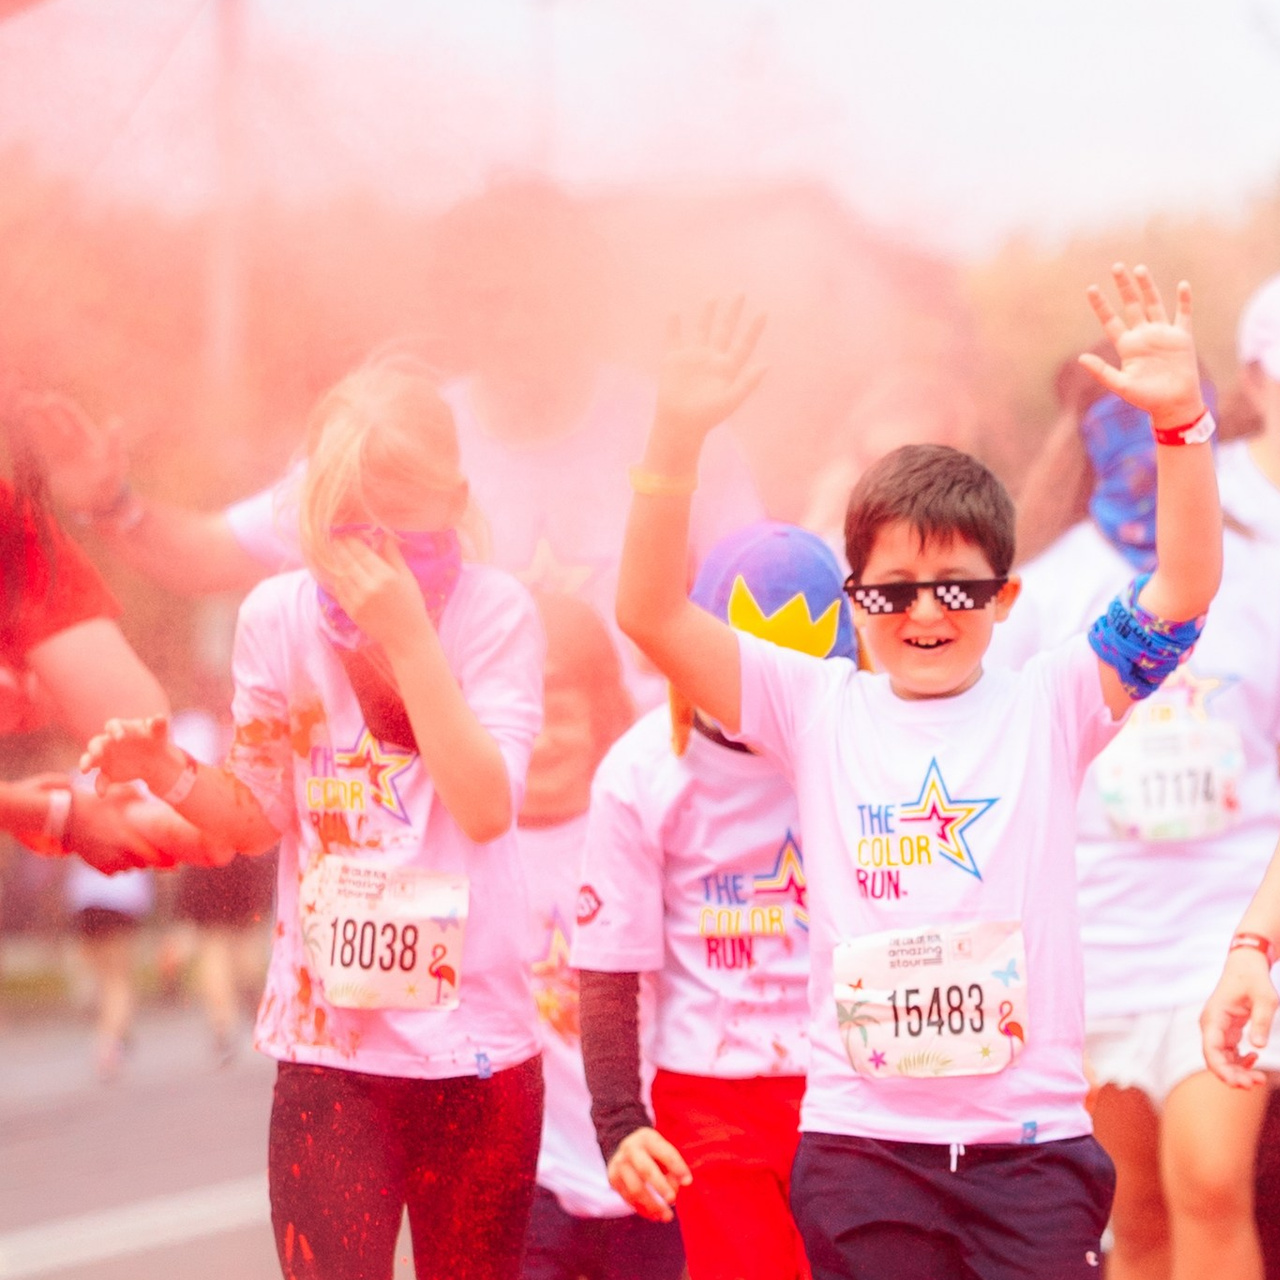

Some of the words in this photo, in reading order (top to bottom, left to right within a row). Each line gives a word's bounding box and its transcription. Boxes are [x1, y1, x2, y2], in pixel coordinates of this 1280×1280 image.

[857, 804, 896, 836] THE
[857, 835, 932, 867] COLOR
[701, 873, 748, 905] THE
[700, 906, 785, 936] COLOR
[329, 917, 420, 972] 18038
[887, 983, 985, 1038] 15483
